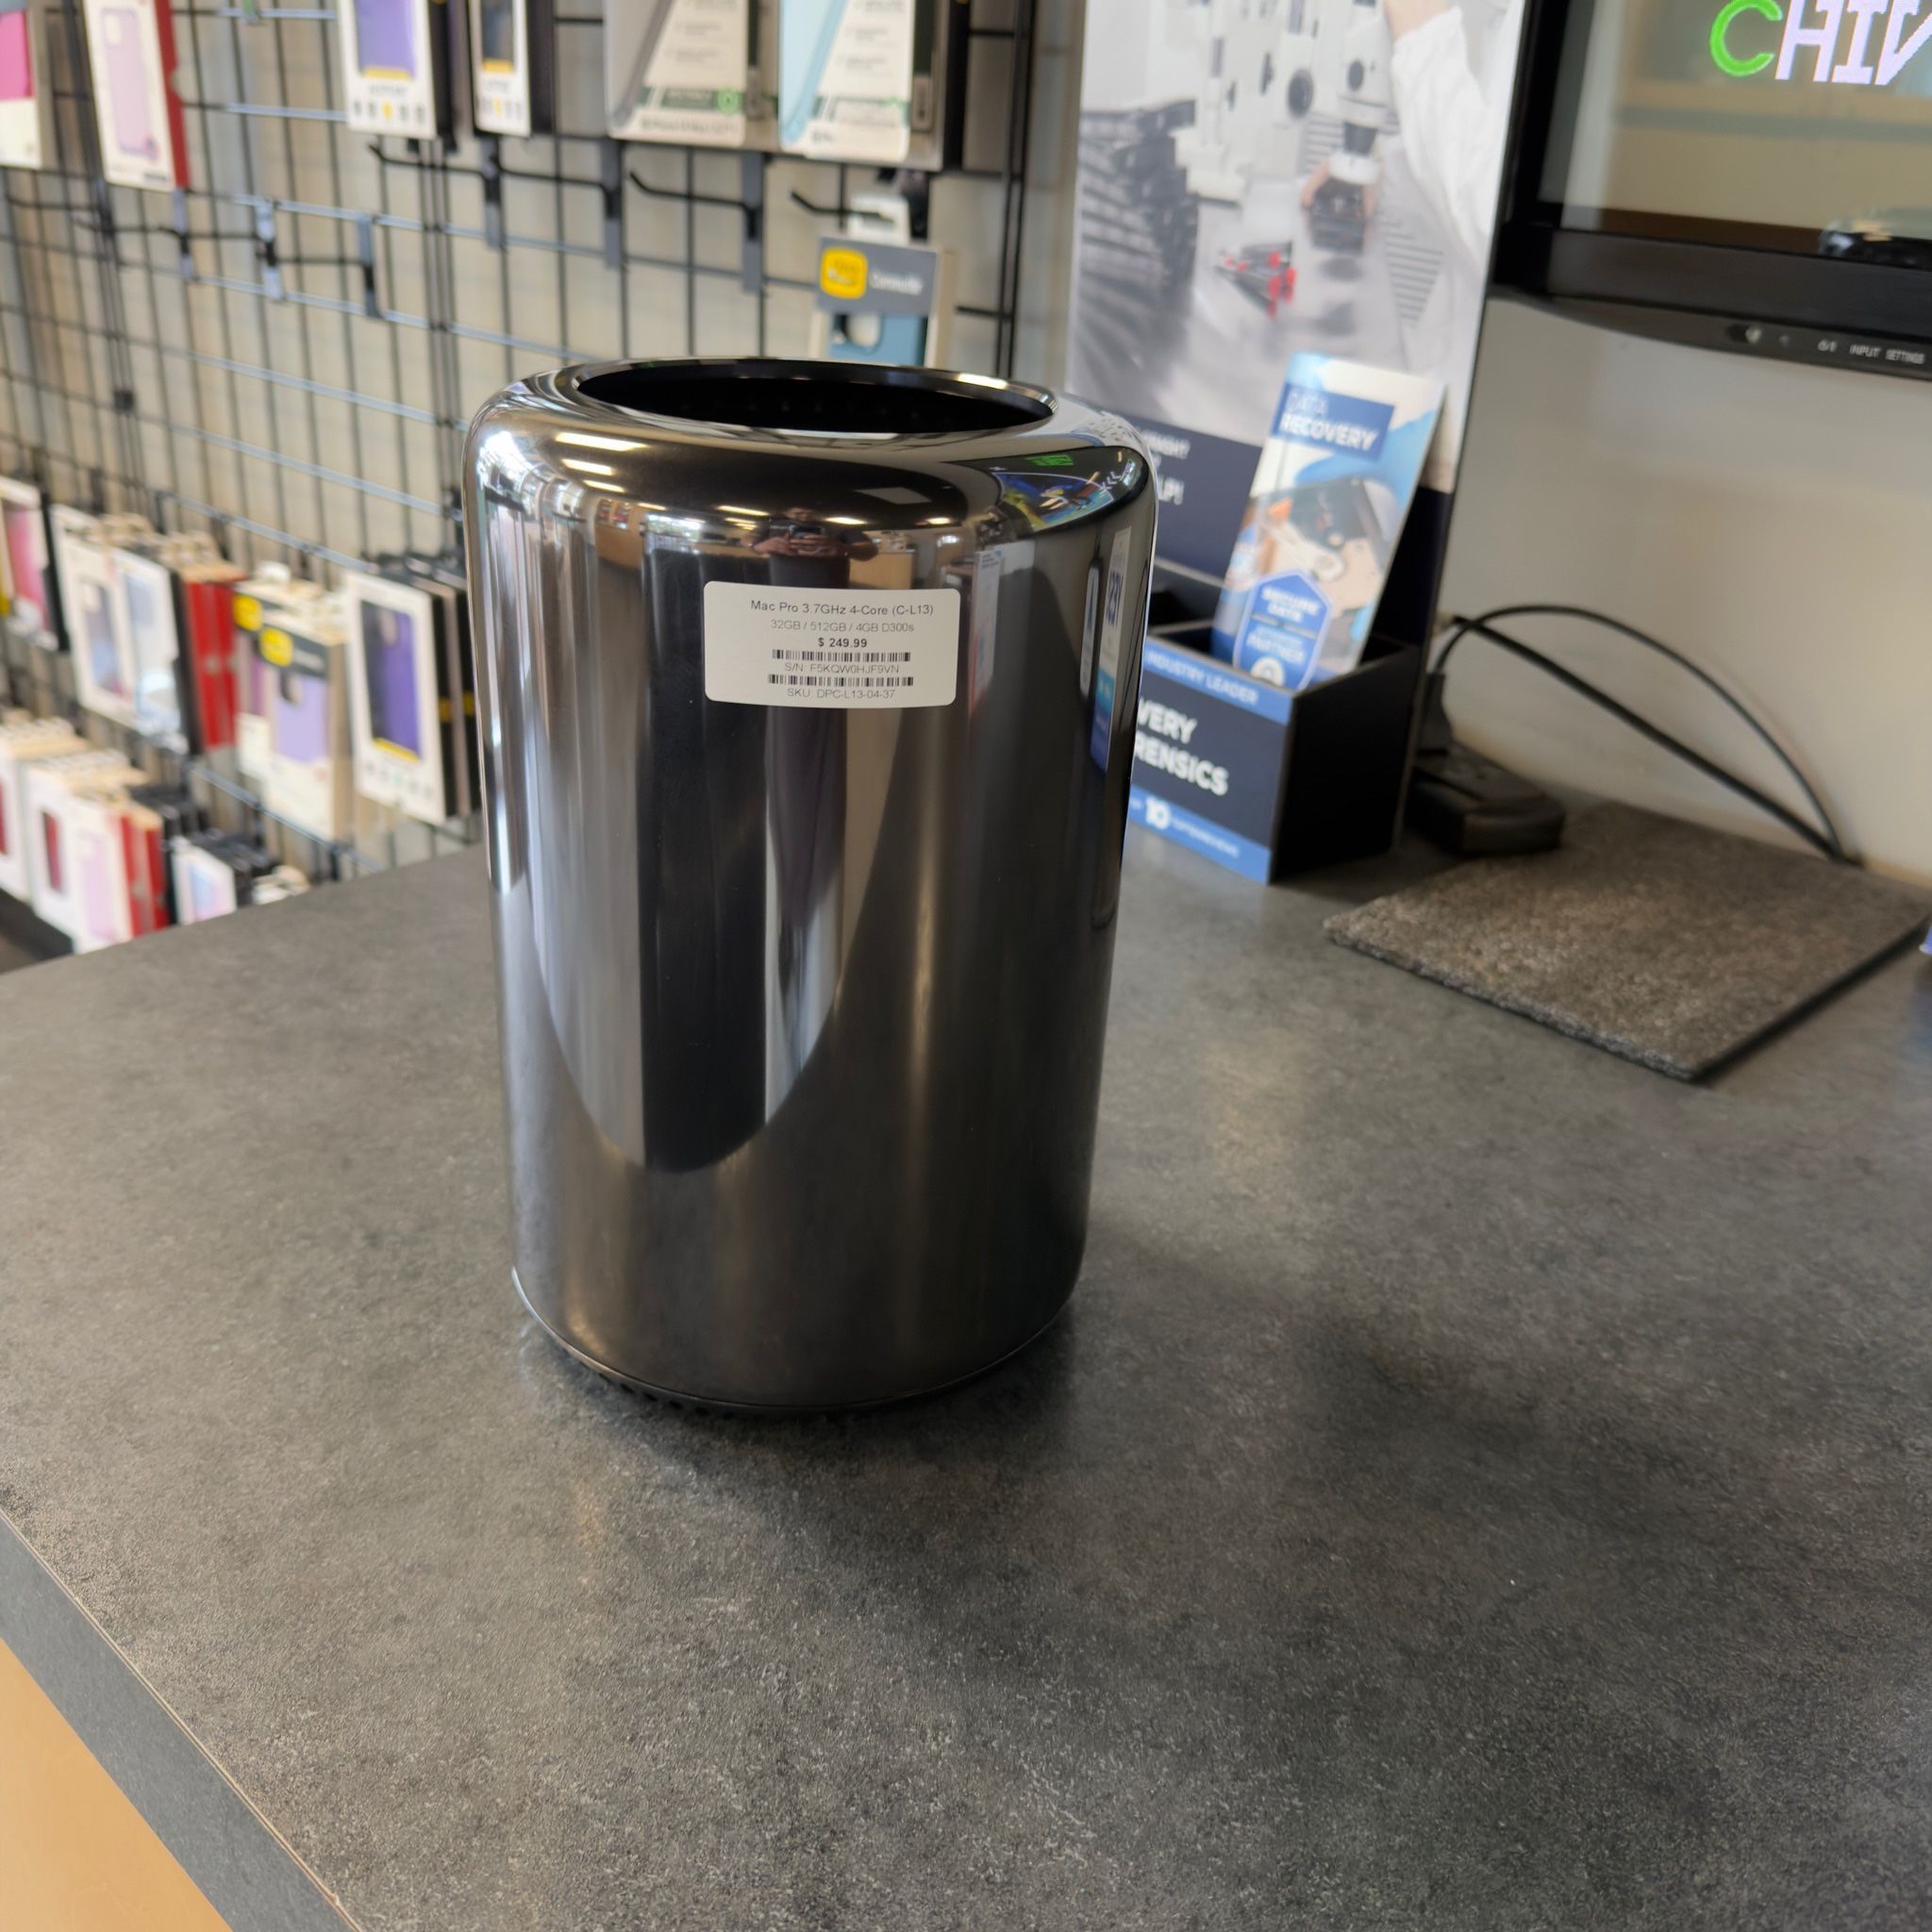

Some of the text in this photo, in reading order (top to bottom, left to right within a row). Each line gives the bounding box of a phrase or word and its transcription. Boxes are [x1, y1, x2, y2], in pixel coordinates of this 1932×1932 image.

[1849, 344, 1925, 364] INPUT SETTINGS
[1279, 413, 1379, 451] RECOVERY
[751, 600, 934, 617] Mac Pro 3.7GHz 4-Core (C-L13)
[771, 619, 801, 630] 32GB
[810, 622, 846, 632] 512GB
[856, 623, 878, 633] 4GB
[881, 623, 914, 633] D300s
[817, 637, 868, 648] $ 249.99
[816, 689, 896, 699] DPC-L13-04-37
[1205, 673, 1258, 707] LEADER
[1134, 729, 1229, 796] RENSICS
